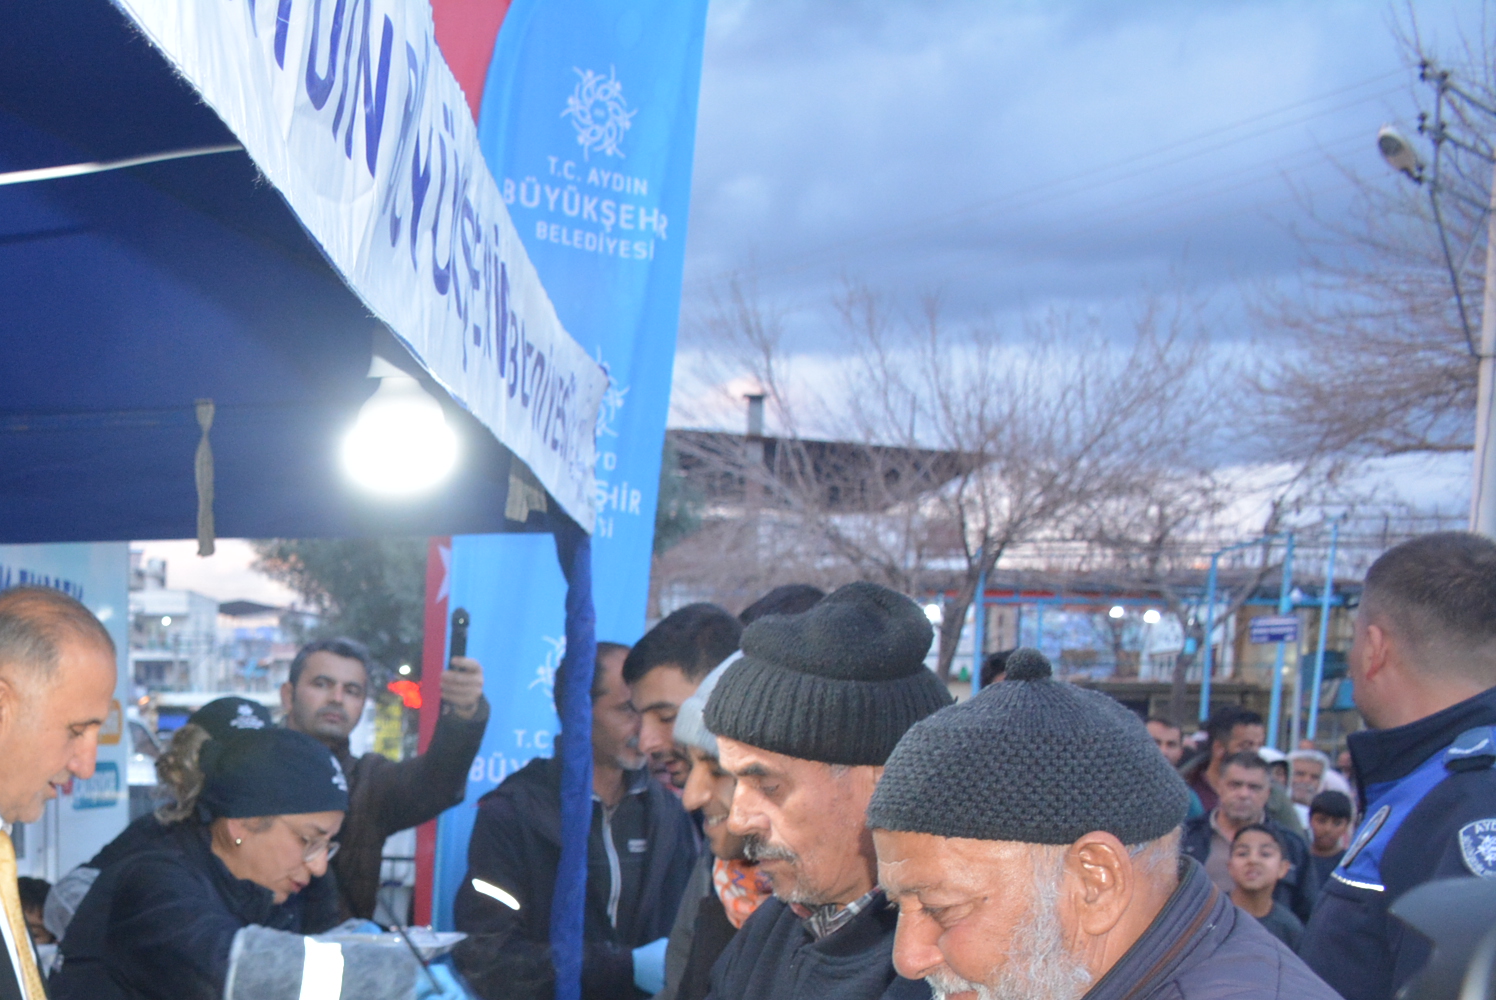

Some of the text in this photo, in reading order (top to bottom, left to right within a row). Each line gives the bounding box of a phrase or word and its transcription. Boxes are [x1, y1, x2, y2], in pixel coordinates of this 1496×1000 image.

[587, 167, 649, 197] AYDIN
[504, 175, 669, 241] BÜYÜKŞEHR
[535, 220, 656, 261] BELEDİYESİ
